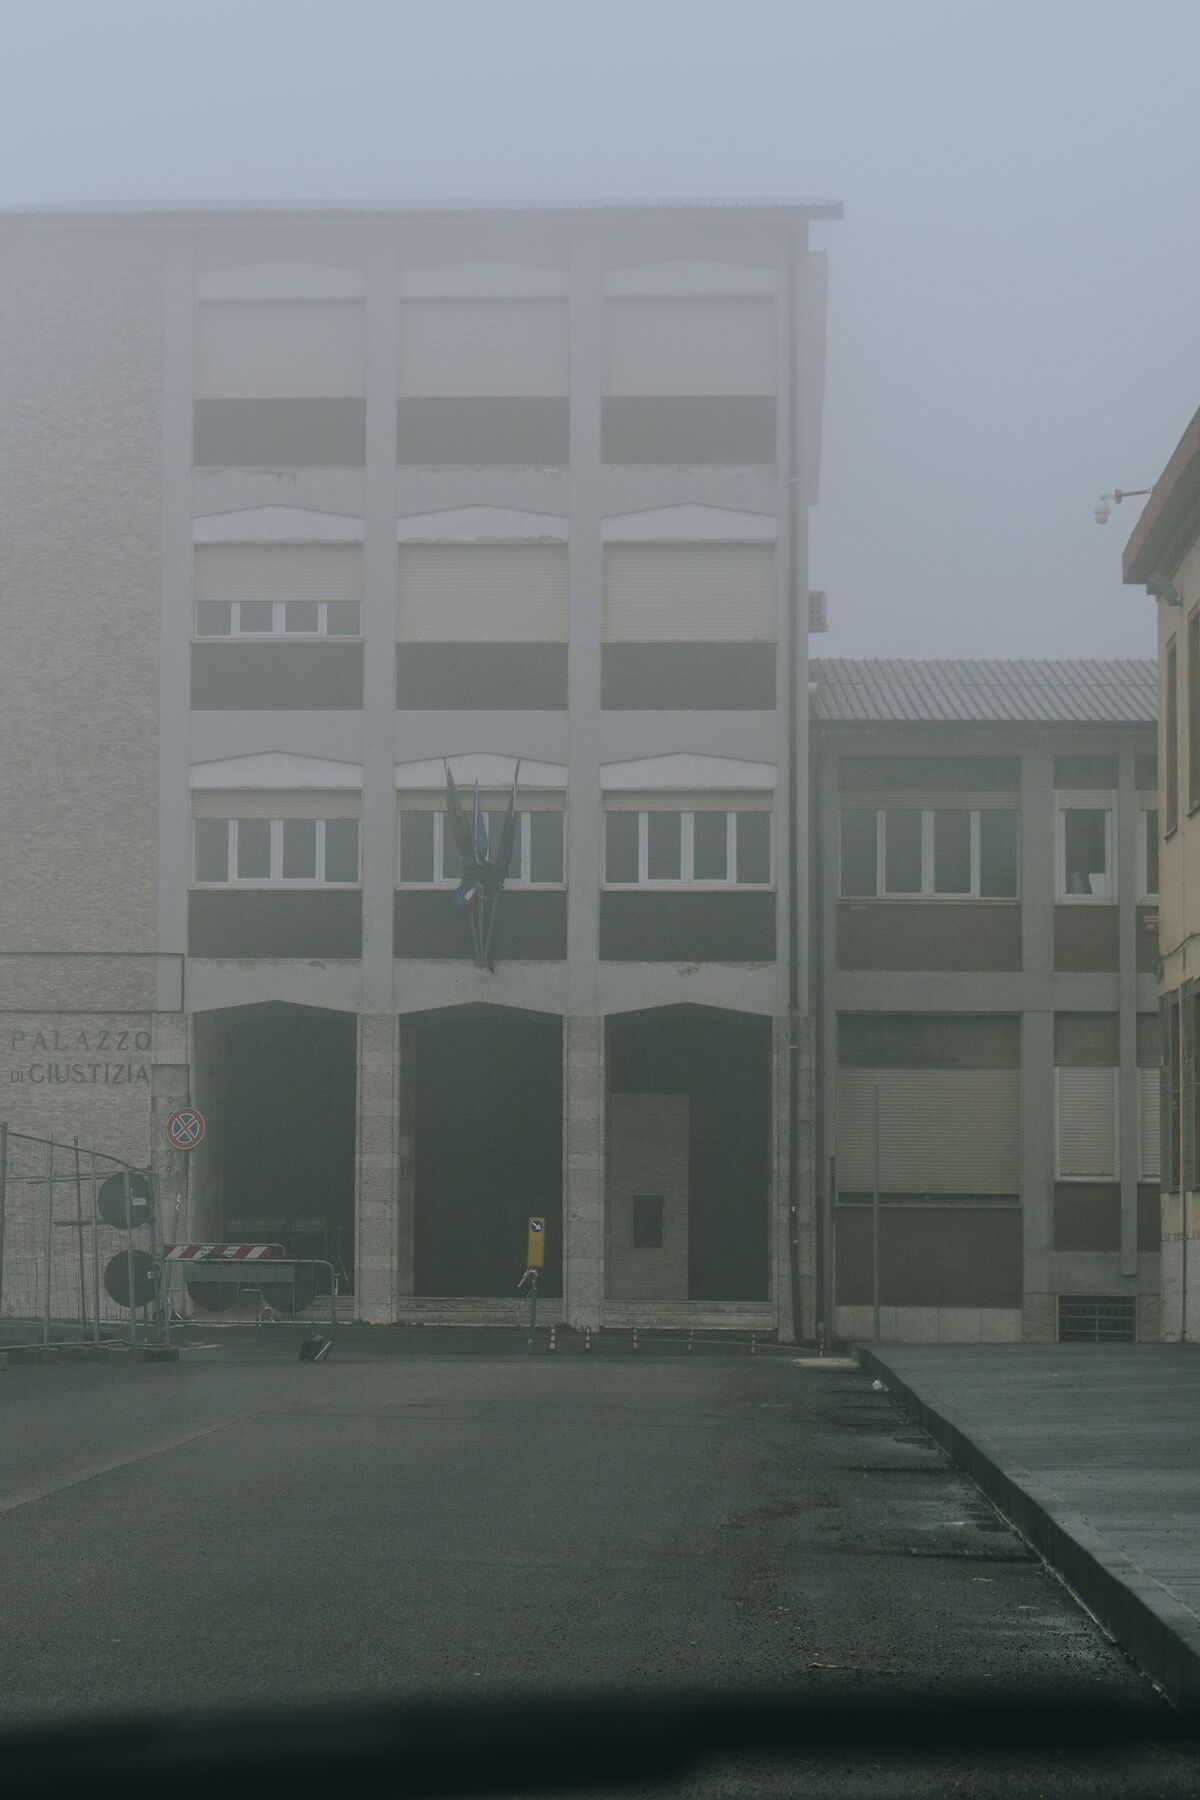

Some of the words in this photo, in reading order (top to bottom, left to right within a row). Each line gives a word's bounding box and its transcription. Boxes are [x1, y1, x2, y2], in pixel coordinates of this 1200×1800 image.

[11, 1030, 152, 1050] PALAZZO
[10, 1071, 24, 1083] DI
[28, 1064, 150, 1084] GIUSTIZIA
